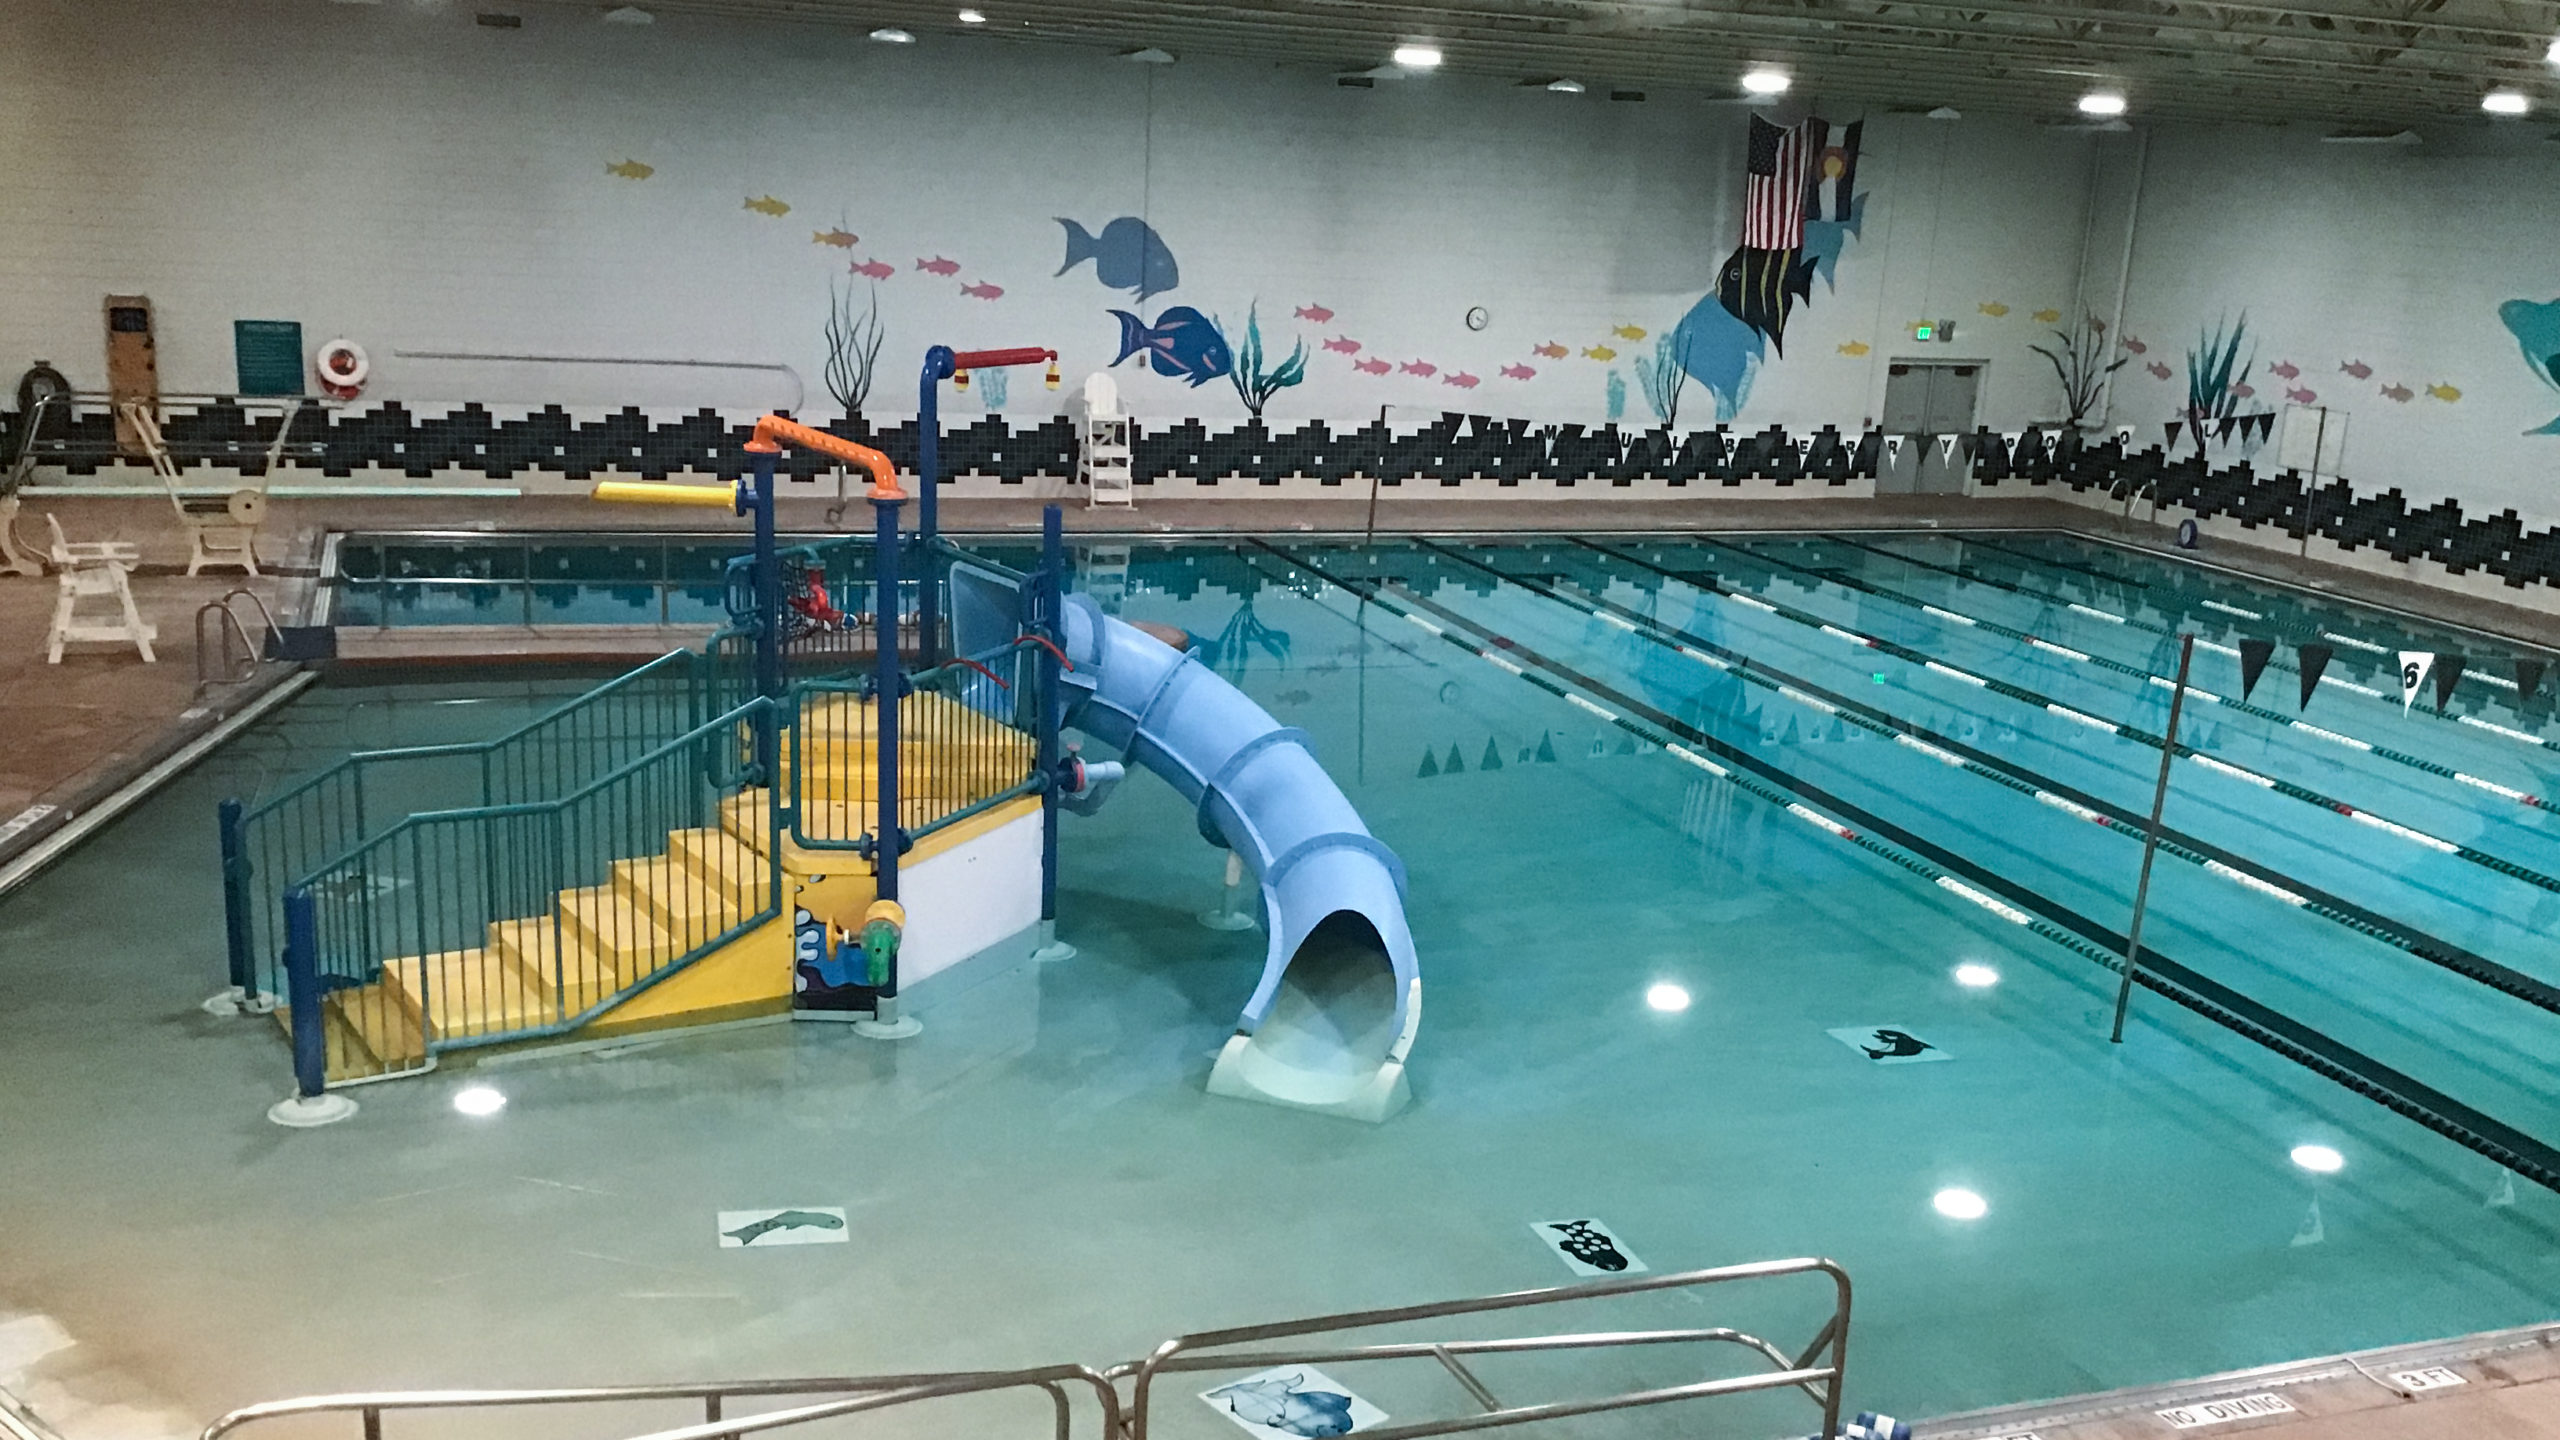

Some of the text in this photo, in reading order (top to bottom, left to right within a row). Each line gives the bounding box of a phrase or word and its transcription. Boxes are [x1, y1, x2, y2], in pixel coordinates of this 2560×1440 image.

[2403, 661, 2420, 689] 6
[2402, 1368, 2456, 1387] 3 FT
[2160, 1396, 2287, 1425] NO DIVING
